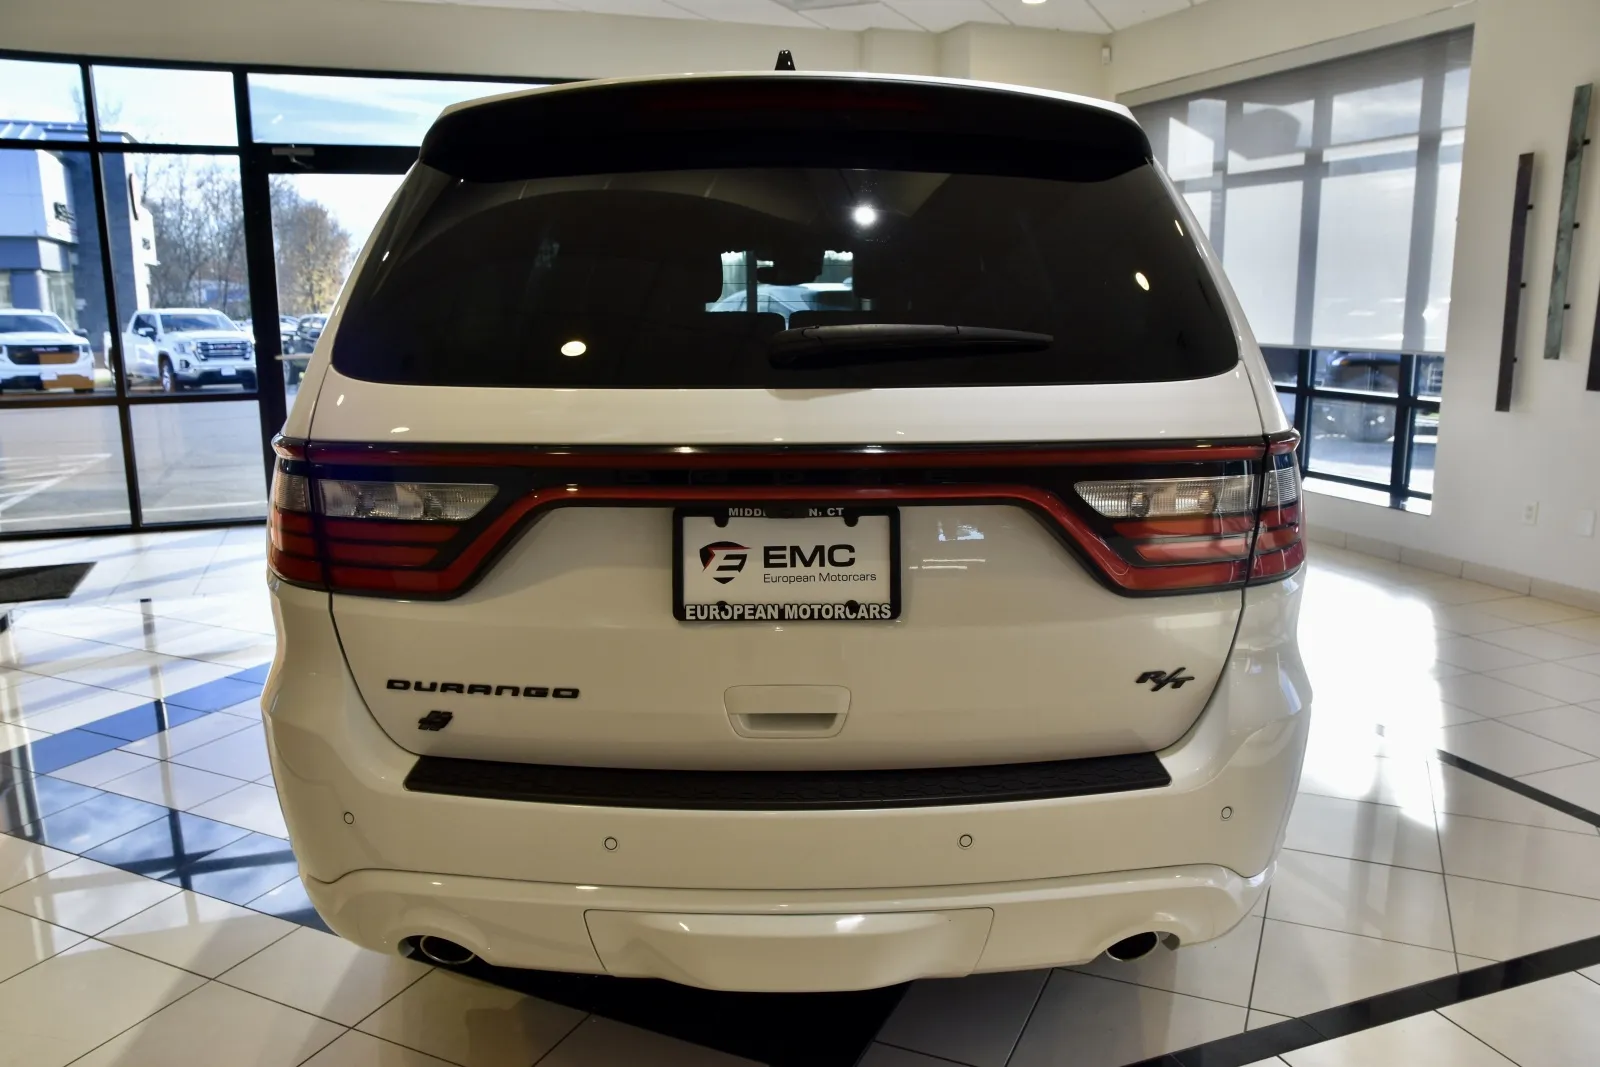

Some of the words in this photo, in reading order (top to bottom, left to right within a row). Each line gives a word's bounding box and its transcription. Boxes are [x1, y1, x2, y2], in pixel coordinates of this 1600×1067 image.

[826, 507, 844, 517] CT
[763, 544, 856, 569] EMC
[763, 573, 816, 584] European
[818, 572, 877, 582] Motorcars
[685, 604, 779, 620] EUROPEAN
[784, 604, 891, 620] MOTORCARS
[1135, 666, 1195, 692] R/T
[386, 679, 580, 699] DURANGO
